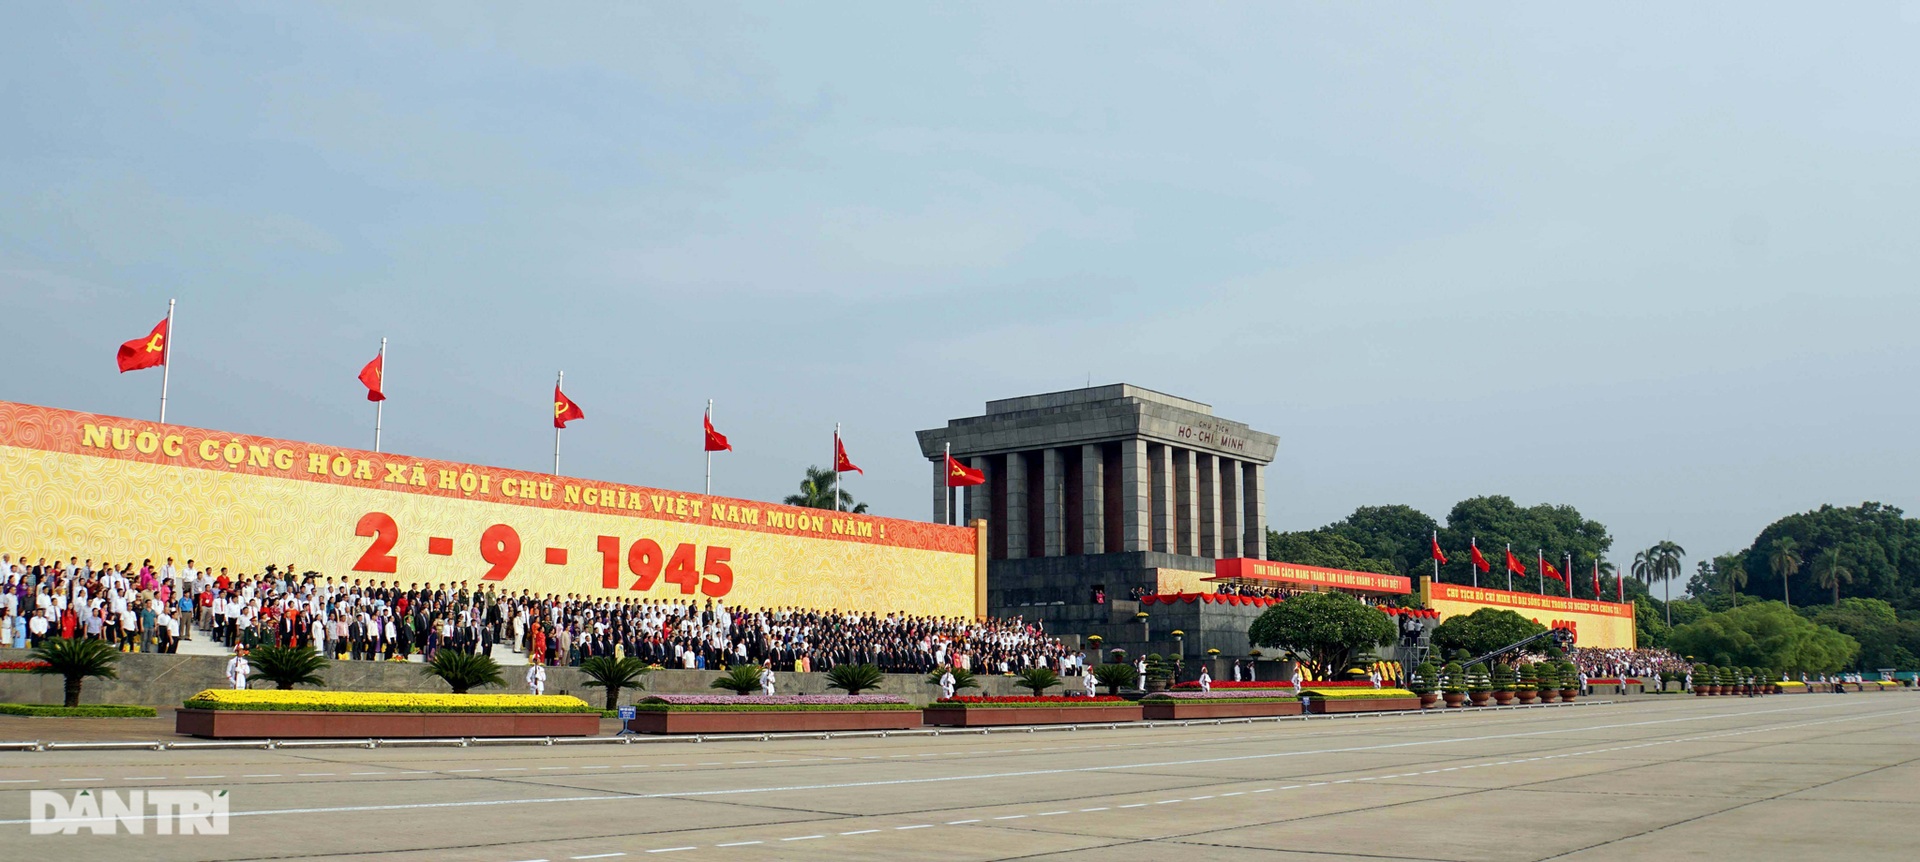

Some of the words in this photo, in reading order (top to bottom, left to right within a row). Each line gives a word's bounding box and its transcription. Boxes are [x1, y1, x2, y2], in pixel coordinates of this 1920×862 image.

[82, 423, 184, 457] NƯỚC
[199, 438, 294, 470] CỘNG
[307, 452, 373, 480] HÒA
[384, 462, 427, 487] XÃ
[438, 469, 490, 496] HỘI
[501, 477, 554, 501] CHỦ
[564, 485, 642, 511] NGHĨA
[650, 495, 703, 520] VIỆT
[711, 503, 759, 525] NAM
[767, 511, 825, 532] MUÔN
[831, 517, 873, 538] NĂM
[352, 512, 398, 573] 2
[481, 523, 521, 582] 9
[597, 535, 734, 598] 1945
[1254, 564, 1266, 575] TINH
[1281, 566, 1294, 578] CÁCH
[1295, 569, 1309, 581] MẠNG
[1310, 569, 1325, 581] THÁNG
[1326, 571, 1336, 583] TÁM
[1356, 575, 1370, 586] KHÁNH
[1446, 586, 1459, 598] CHỦ
[1460, 589, 1474, 602] TỊCH
[1475, 588, 1484, 600] HỒ
[1485, 591, 1495, 602] CHÍ
[1496, 593, 1511, 603] MINH
